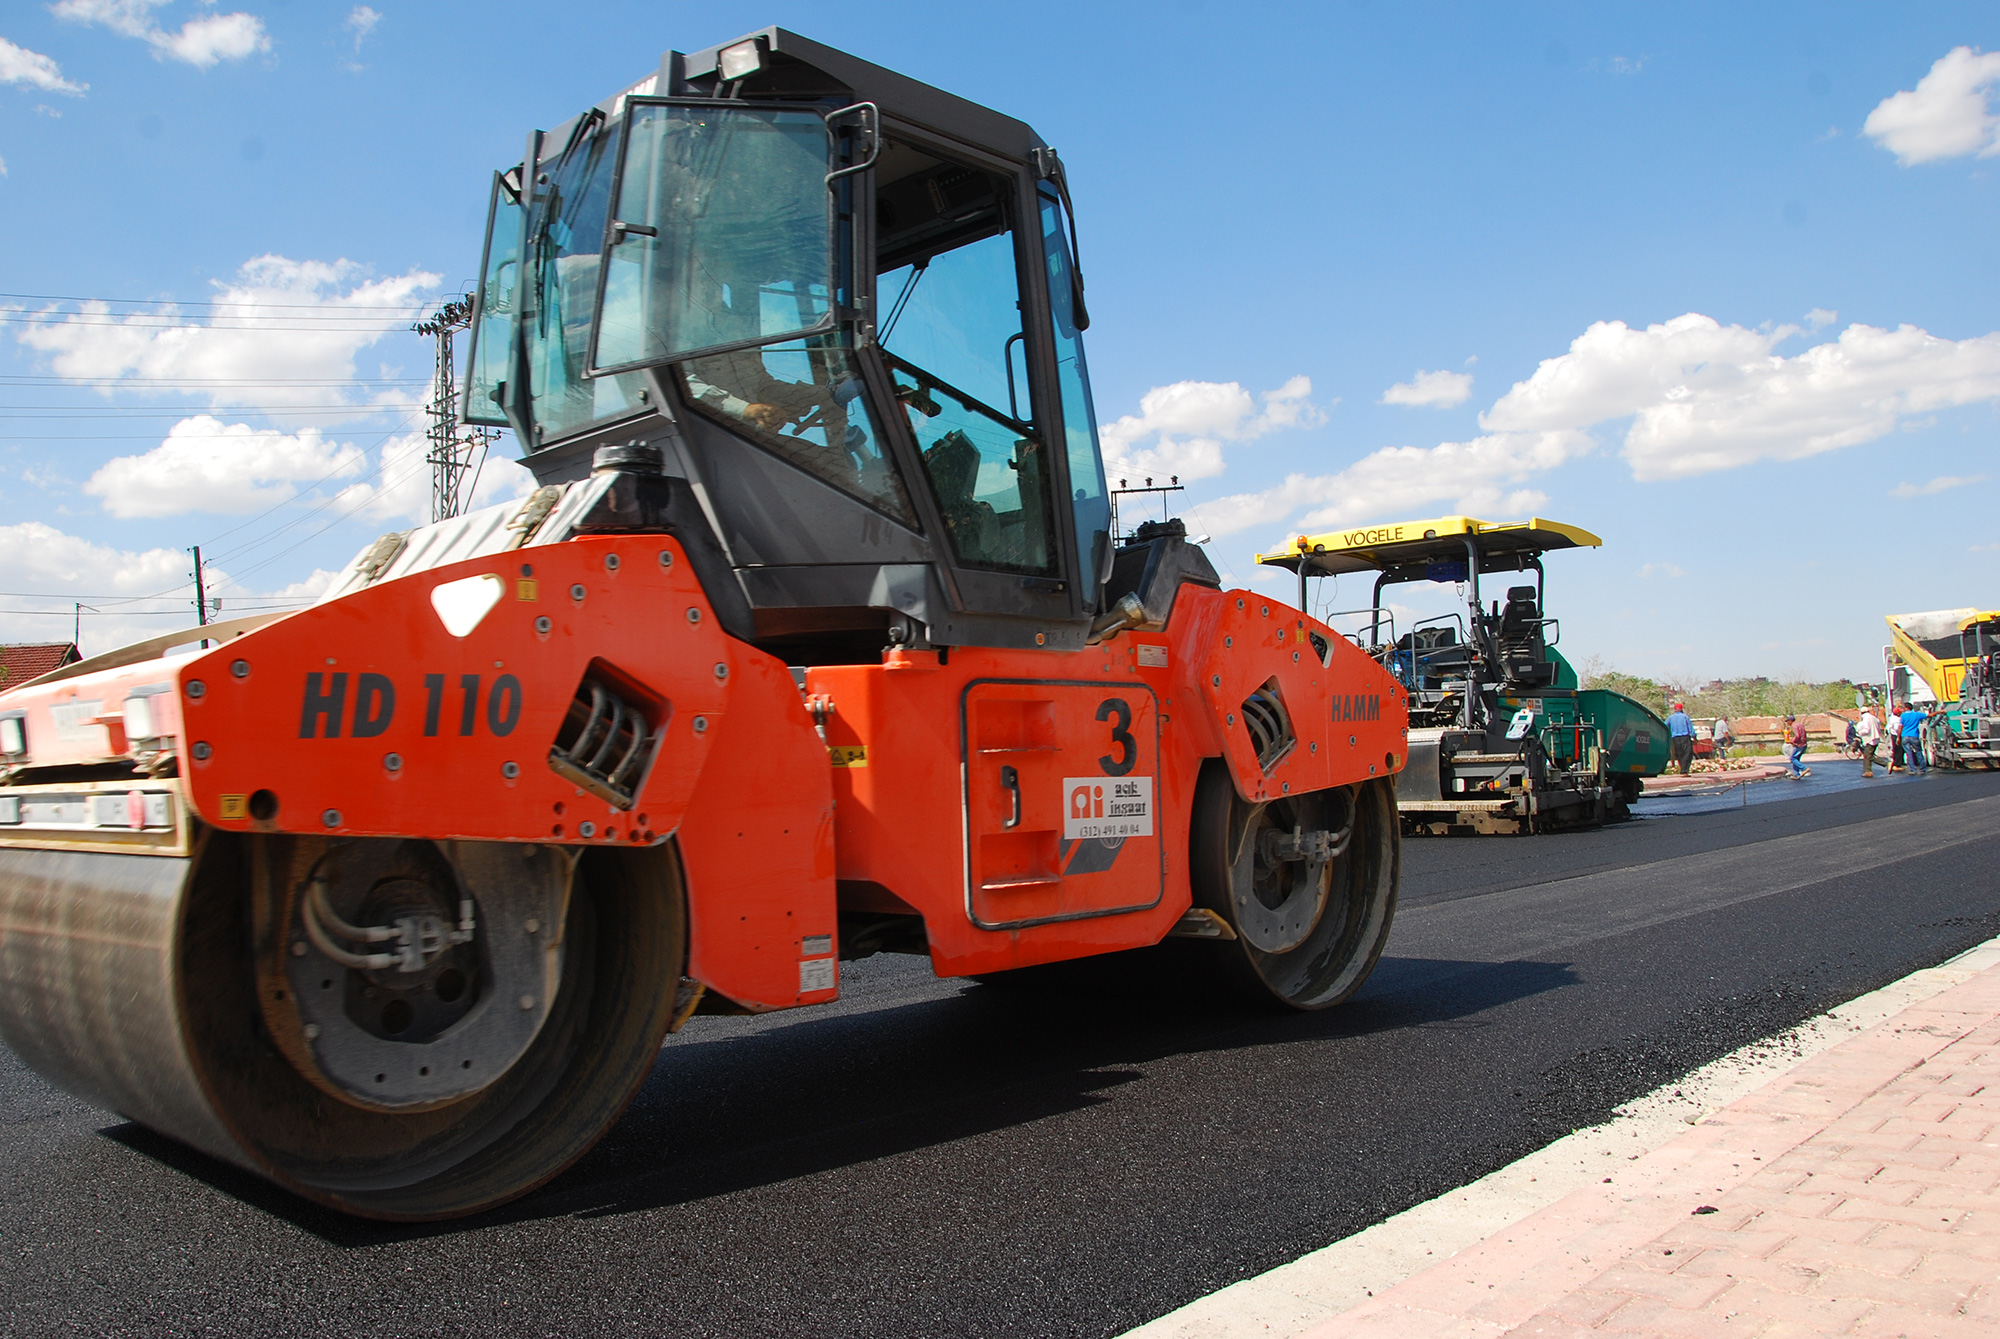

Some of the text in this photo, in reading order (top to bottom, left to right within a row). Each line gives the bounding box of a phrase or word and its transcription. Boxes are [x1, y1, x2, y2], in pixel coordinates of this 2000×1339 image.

[1344, 527, 1404, 546] VÖGELE
[298, 671, 522, 739] HD 110
[1331, 694, 1380, 722] HAMM
[1095, 697, 1137, 777] 3
[1080, 825, 1101, 838] (312)
[1103, 825, 1116, 836] 491
